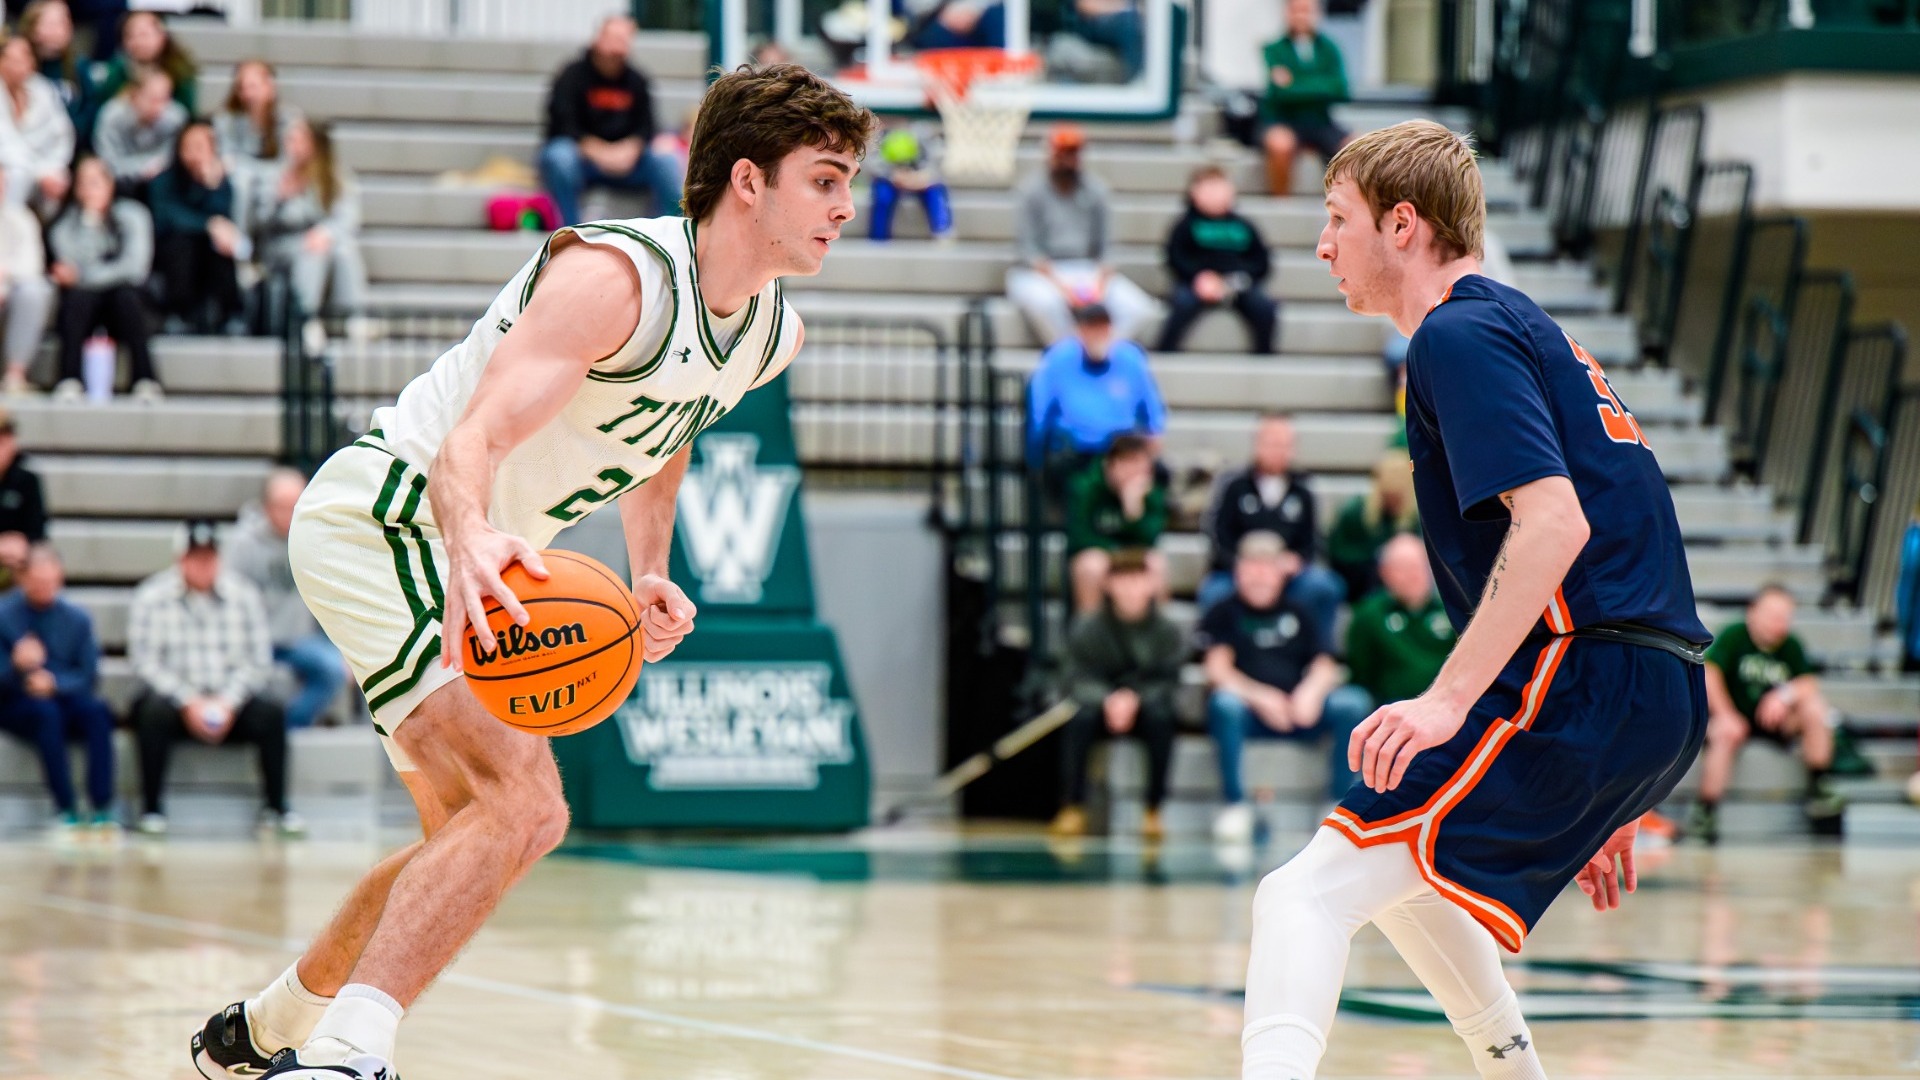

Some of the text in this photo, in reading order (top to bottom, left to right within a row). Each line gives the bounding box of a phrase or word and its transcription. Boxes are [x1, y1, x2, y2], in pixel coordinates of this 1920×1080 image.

[544, 465, 652, 523] 2
[468, 621, 588, 667] Wilson
[576, 671, 598, 689] NXT
[644, 667, 830, 714] ILLINOIS
[617, 699, 854, 764] WESLEYAN
